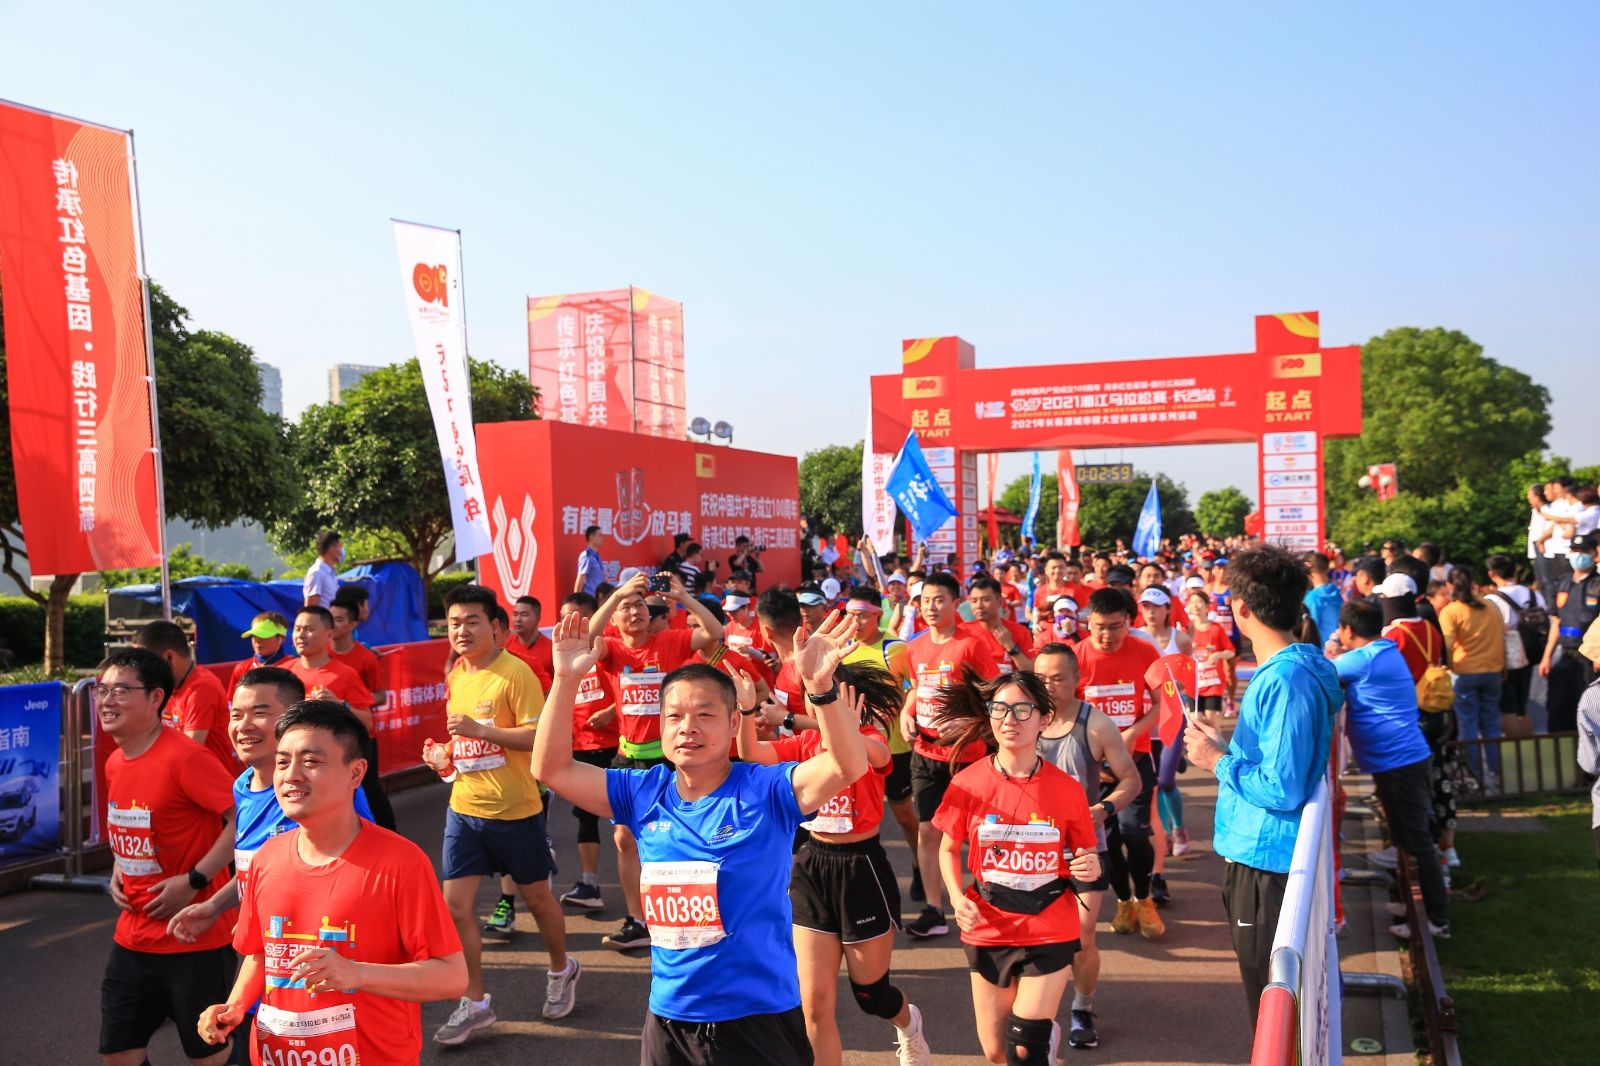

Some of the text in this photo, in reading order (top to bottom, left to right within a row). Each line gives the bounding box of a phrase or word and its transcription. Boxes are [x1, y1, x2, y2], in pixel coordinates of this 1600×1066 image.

[1265, 388, 1312, 411] 起点
[911, 408, 951, 428] 起点
[1264, 411, 1312, 424] START
[562, 505, 693, 538] 有能量 放马来
[24, 700, 48, 711] Jeep
[108, 829, 154, 857] A11324
[982, 848, 1059, 872] A20662
[645, 895, 717, 923] A10389
